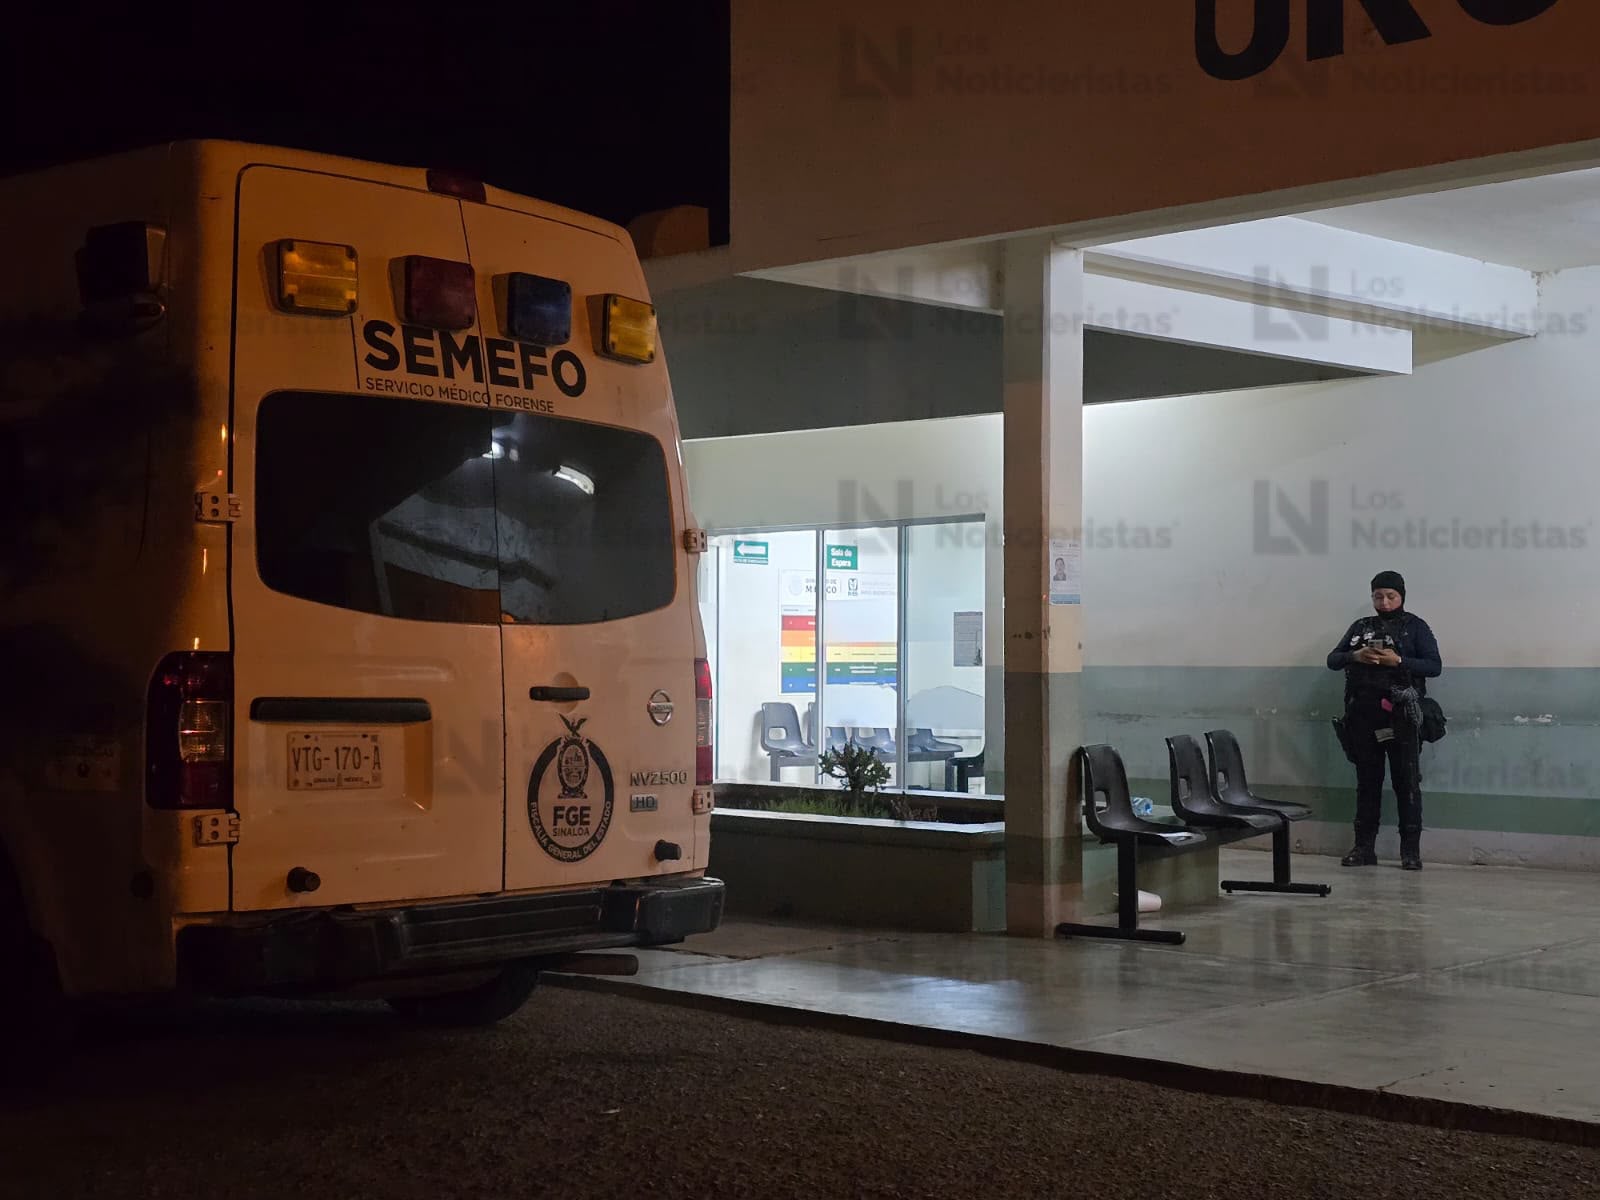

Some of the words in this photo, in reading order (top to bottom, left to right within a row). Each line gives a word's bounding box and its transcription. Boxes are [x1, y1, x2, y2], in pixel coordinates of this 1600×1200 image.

[363, 319, 588, 398] SEMEFO
[366, 377, 434, 397] SERVICIO
[439, 384, 491, 405] MÉDICO
[496, 393, 554, 413] FORENSE
[292, 745, 381, 772] VTG-170-A
[630, 770, 688, 787] NV2500
[635, 796, 656, 809] HD
[553, 805, 591, 828] FGE
[553, 828, 591, 838] SINALOA
